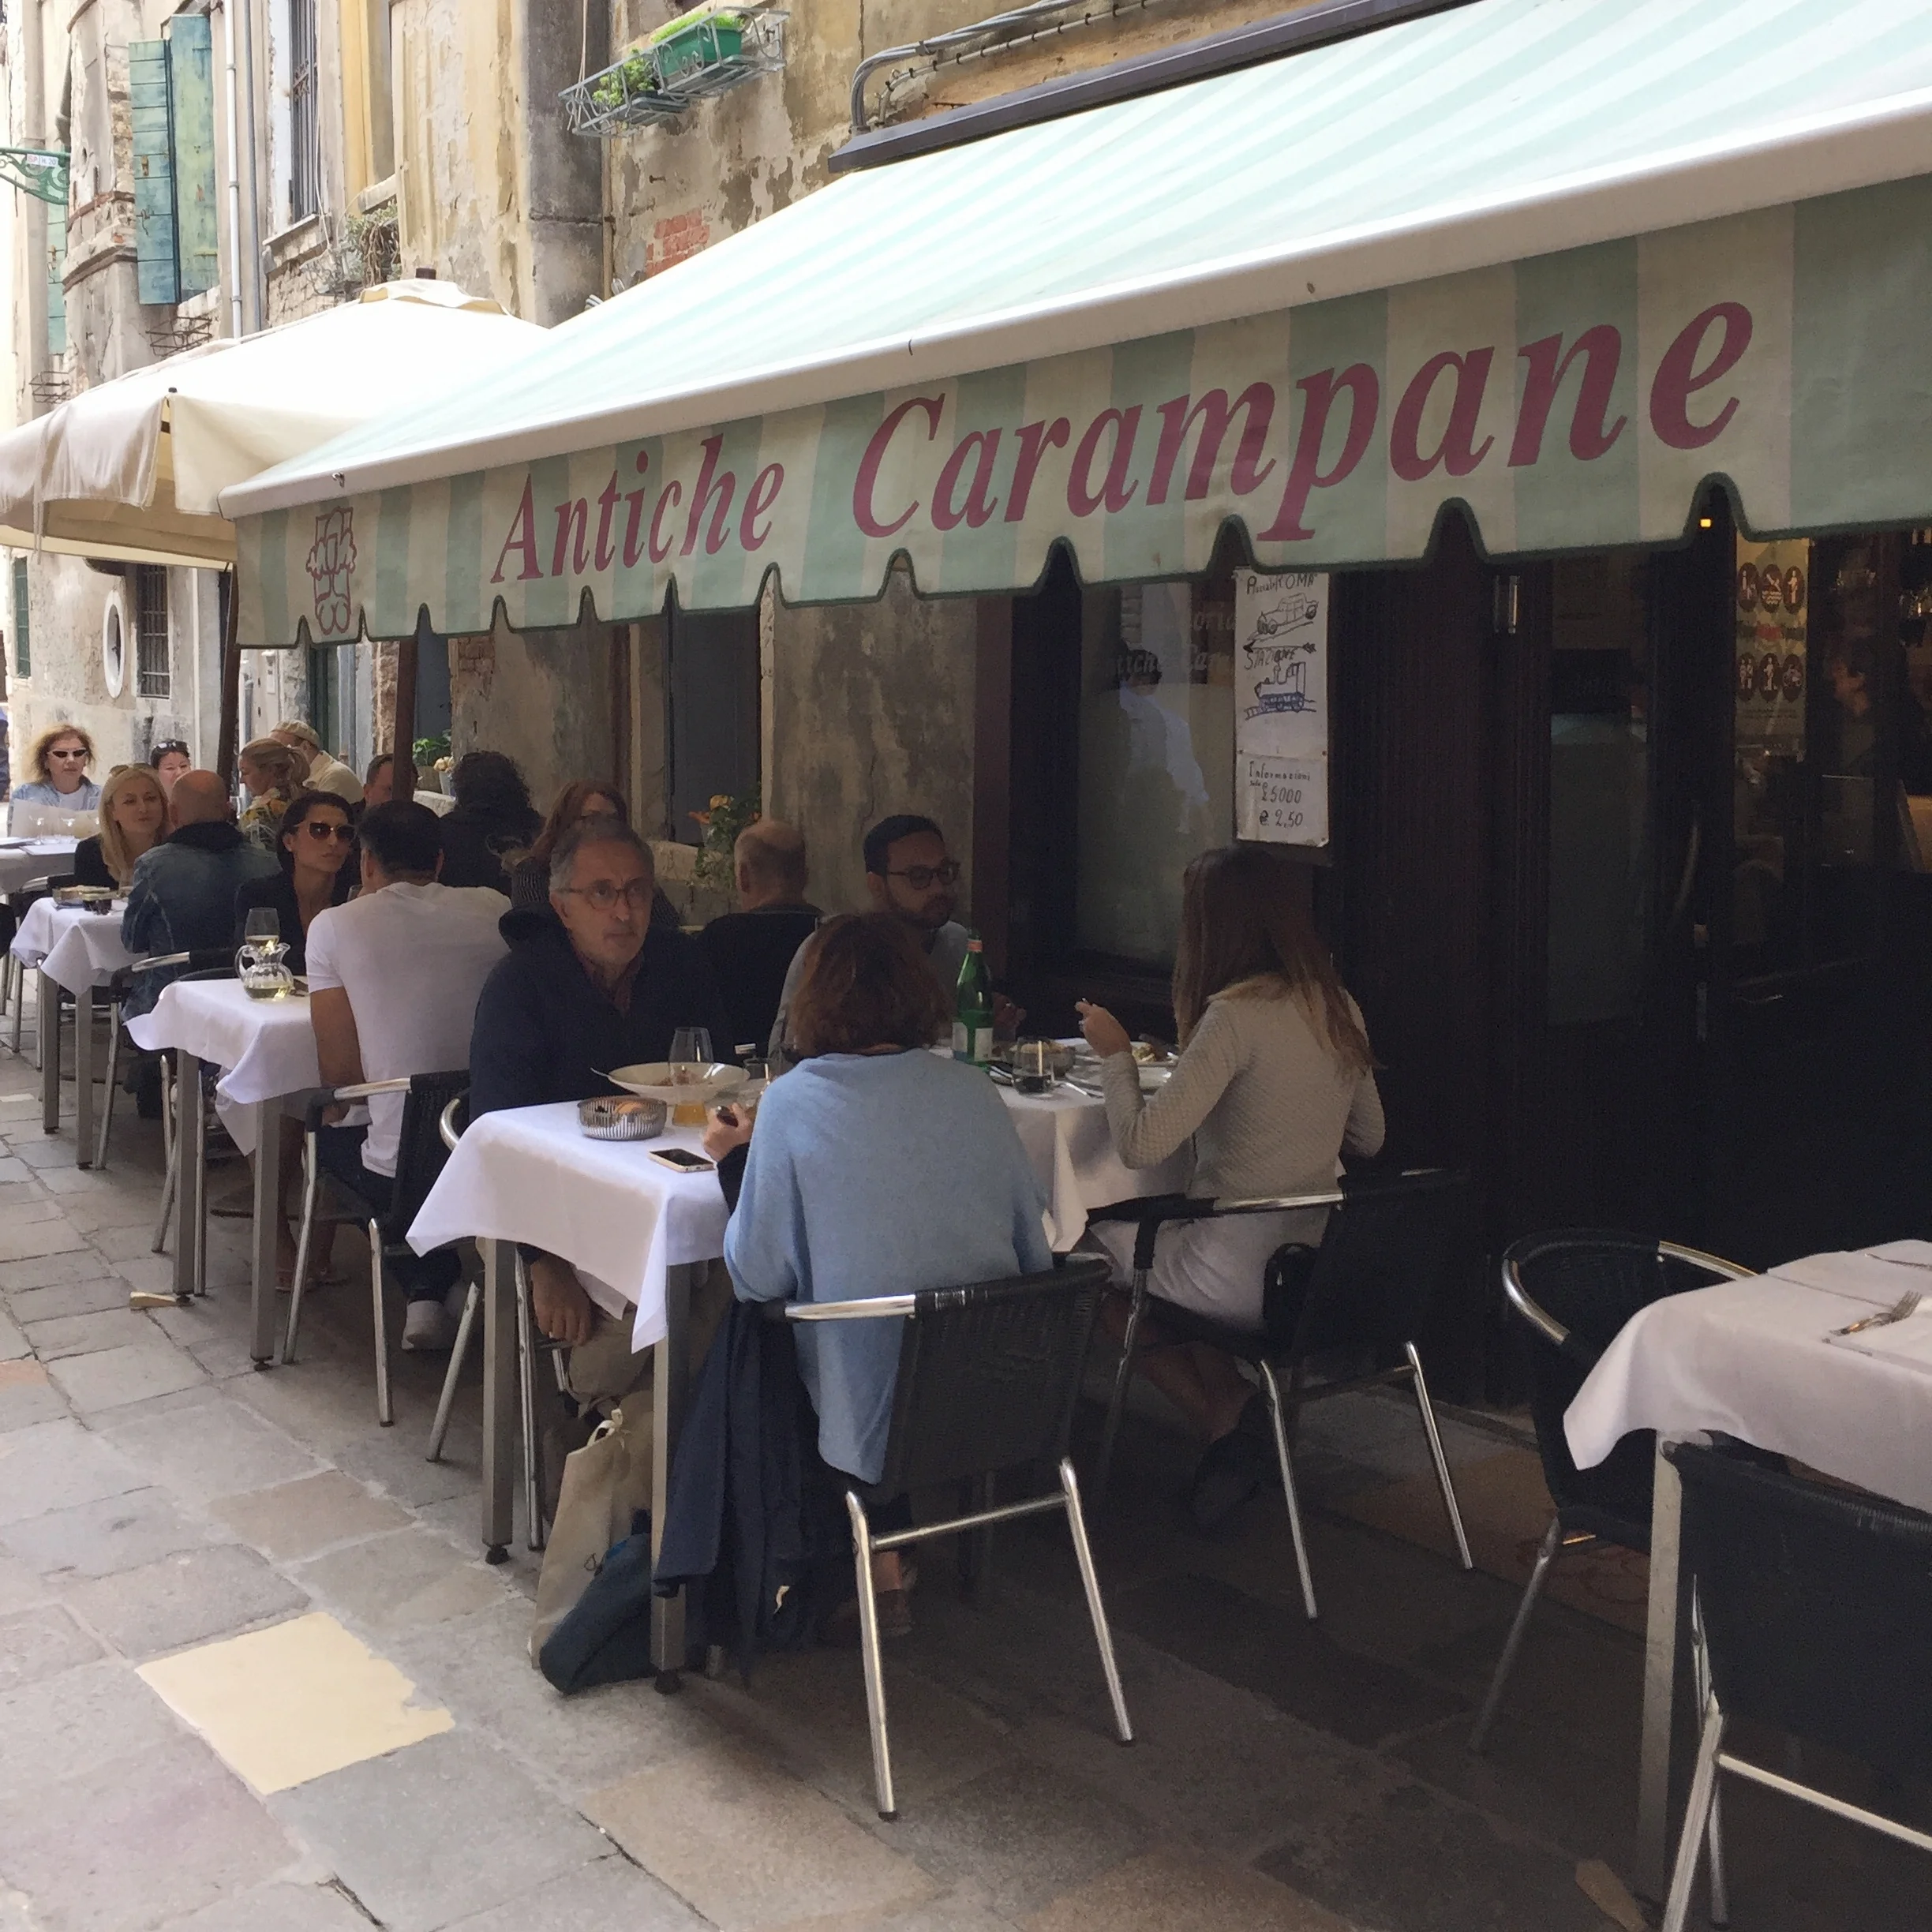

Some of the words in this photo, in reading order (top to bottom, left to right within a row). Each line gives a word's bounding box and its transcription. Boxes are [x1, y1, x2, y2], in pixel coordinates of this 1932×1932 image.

[489, 432, 784, 584] Antiche
[851, 301, 1754, 542] Carampane
[1249, 760, 1310, 781] Informazioni
